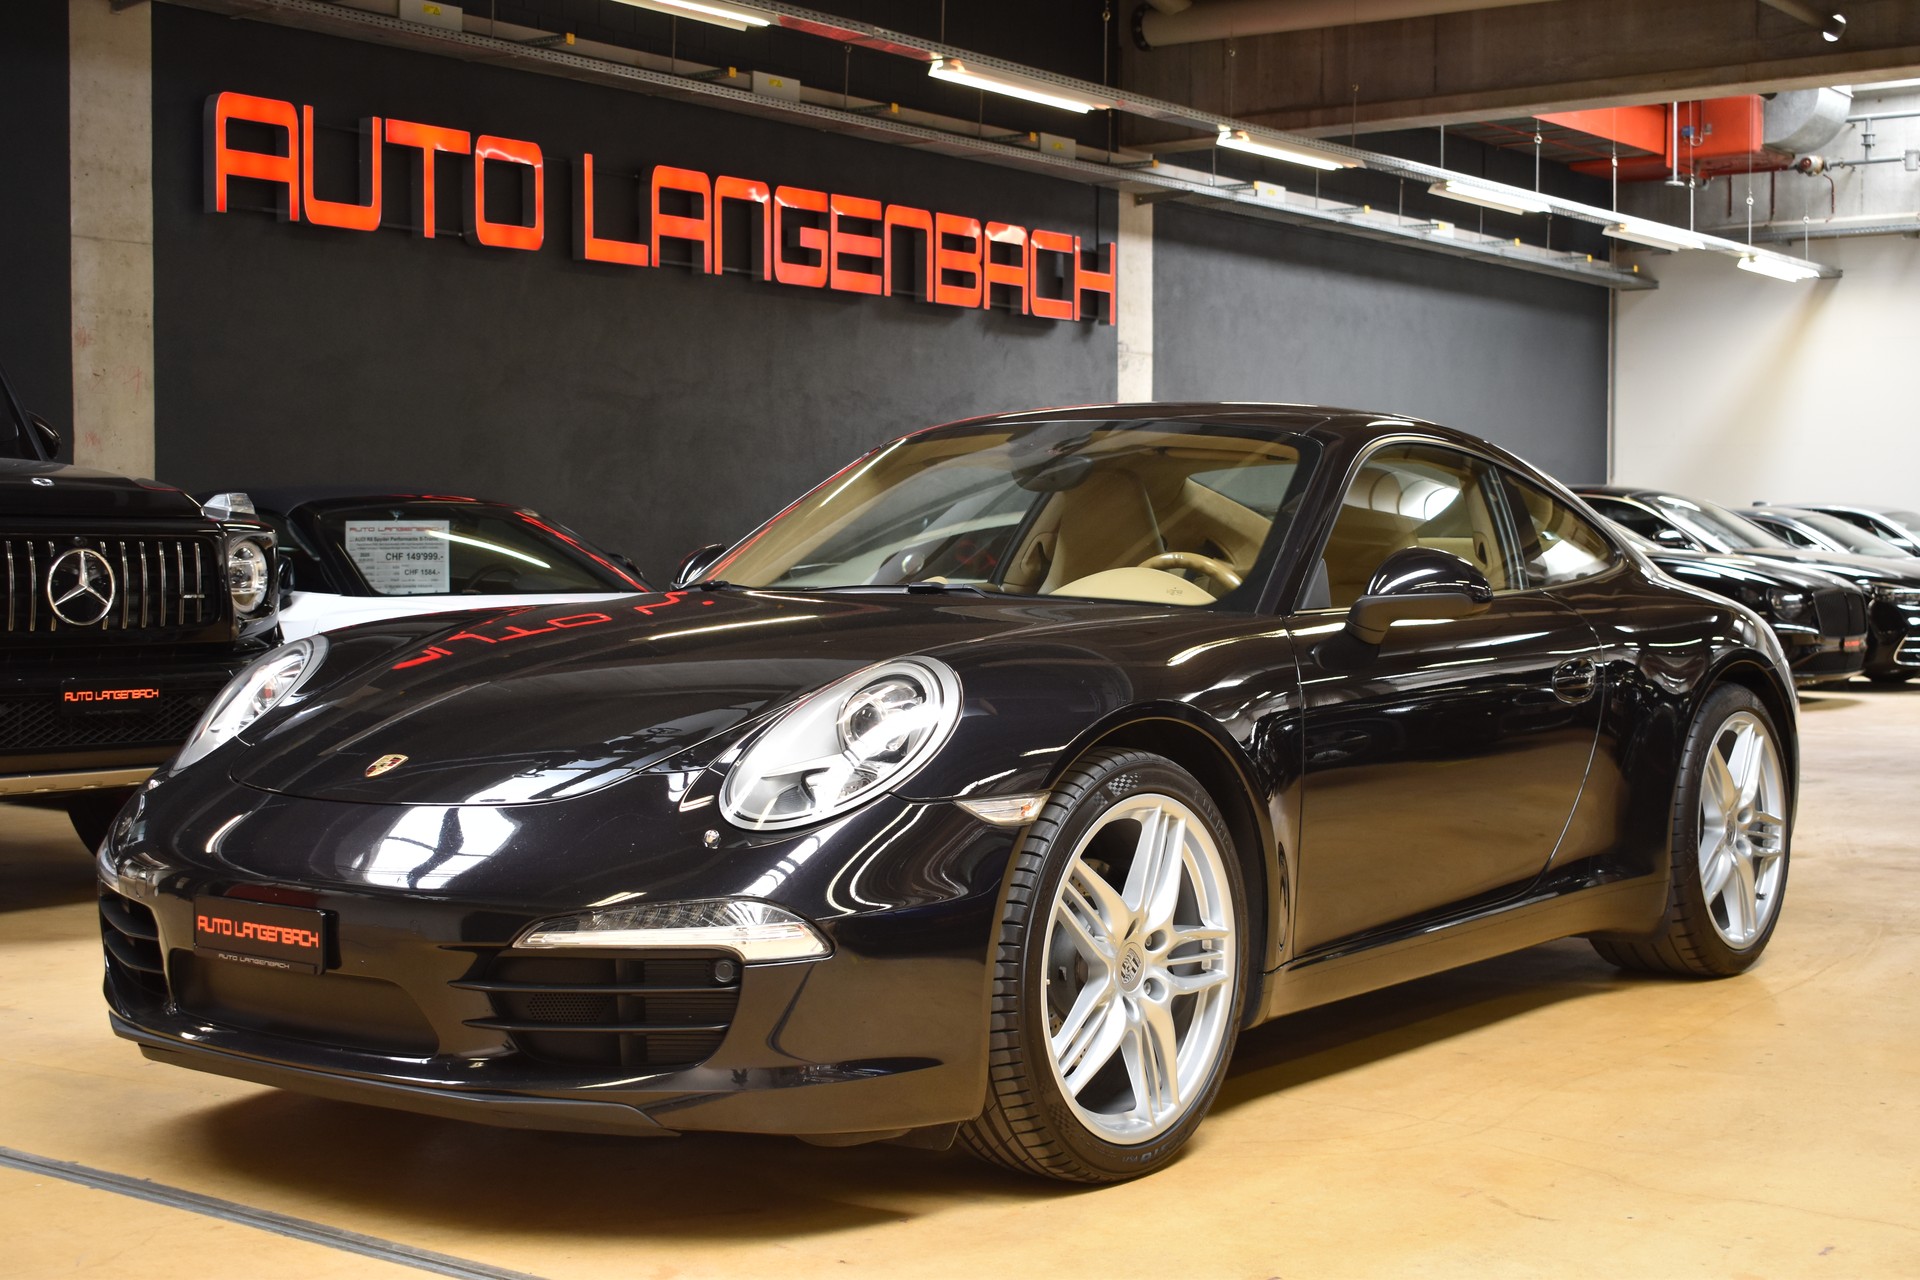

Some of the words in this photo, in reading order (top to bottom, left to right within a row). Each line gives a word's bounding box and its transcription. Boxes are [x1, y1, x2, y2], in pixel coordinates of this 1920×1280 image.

[214, 91, 545, 251] AUTO
[583, 153, 1116, 325] LANGENBACH
[385, 552, 404, 561] CHF
[406, 552, 444, 561] 149'999.-
[64, 691, 93, 702] AUTO
[95, 688, 159, 701] LANGENBACH
[197, 914, 232, 936] AUTO
[234, 921, 320, 949] LANGENBACH
[218, 953, 238, 961] AUTO
[239, 956, 290, 969] LANGENBACH
